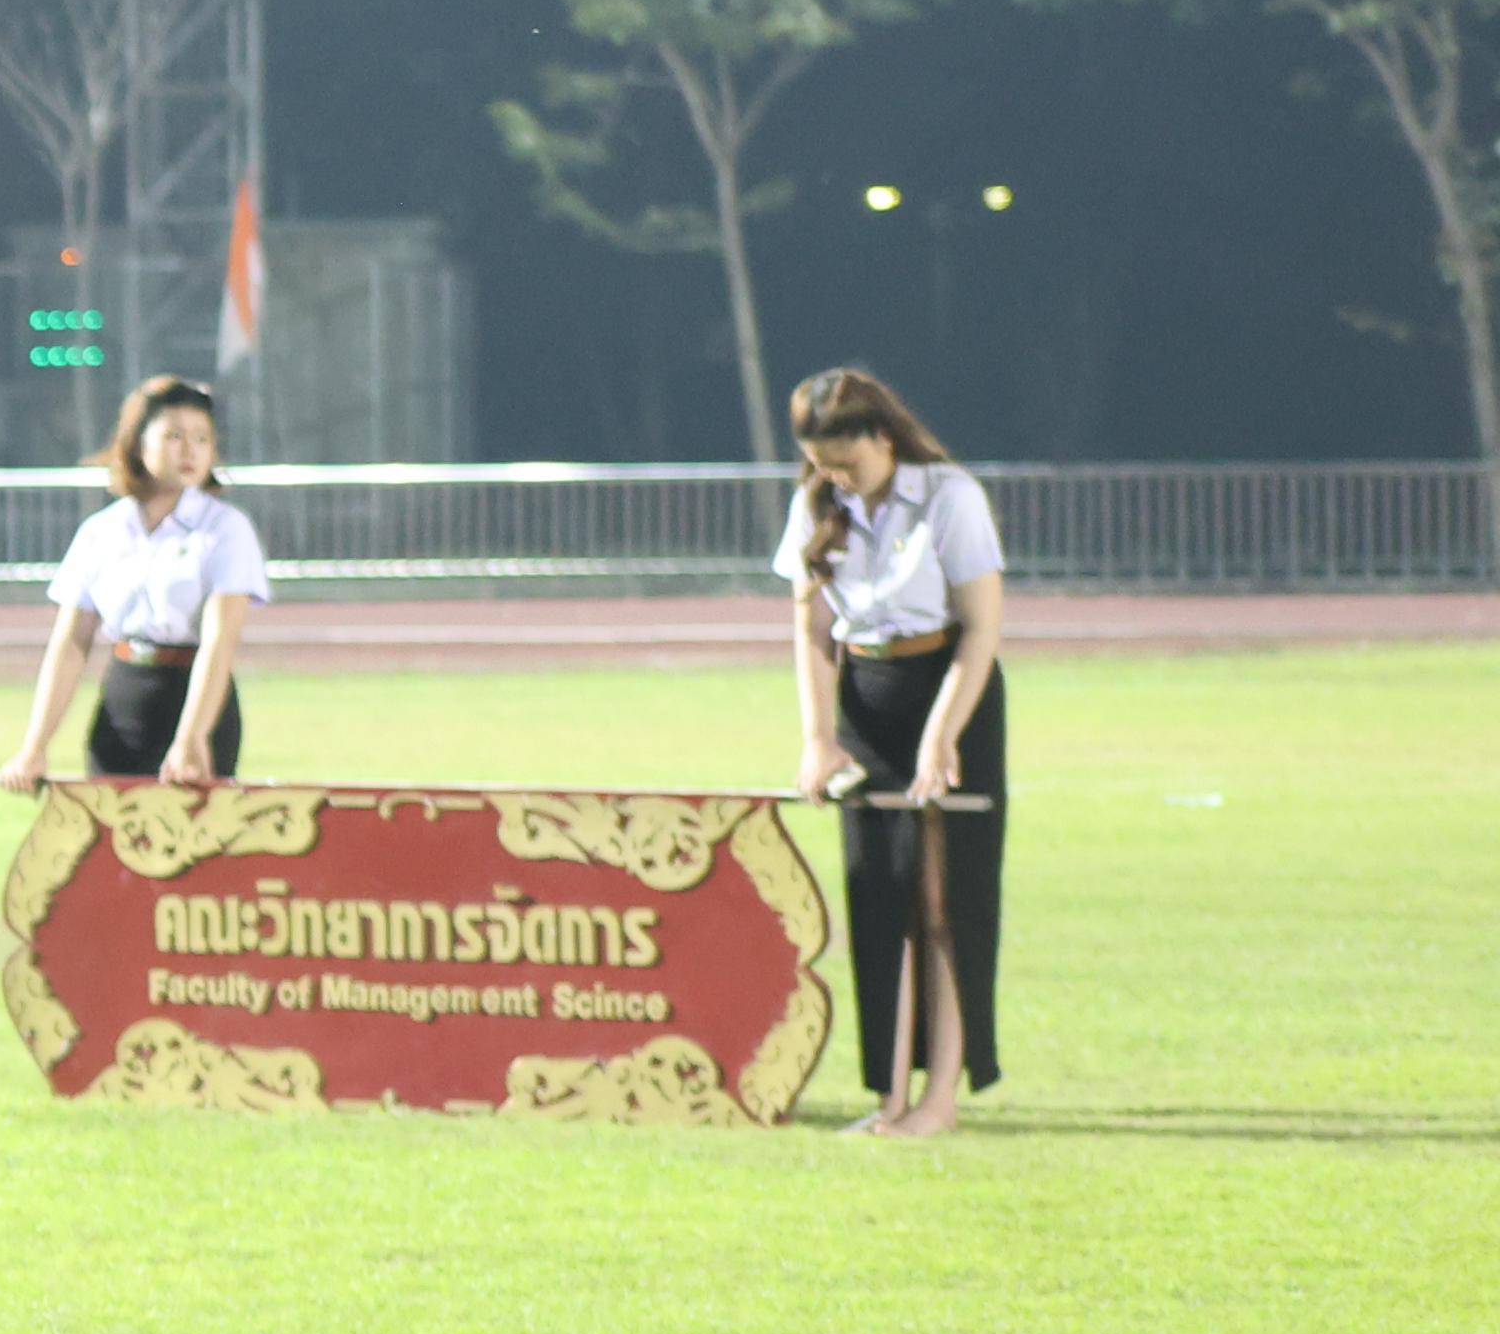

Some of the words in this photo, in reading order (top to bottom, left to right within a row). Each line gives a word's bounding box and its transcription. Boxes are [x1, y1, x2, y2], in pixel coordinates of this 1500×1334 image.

[154, 877, 661, 968] คณะวิทยาการจัดการ
[147, 968, 271, 1015] Faculty
[276, 973, 313, 1010] of
[321, 972, 541, 1023] Management
[551, 979, 670, 1023] Scince
